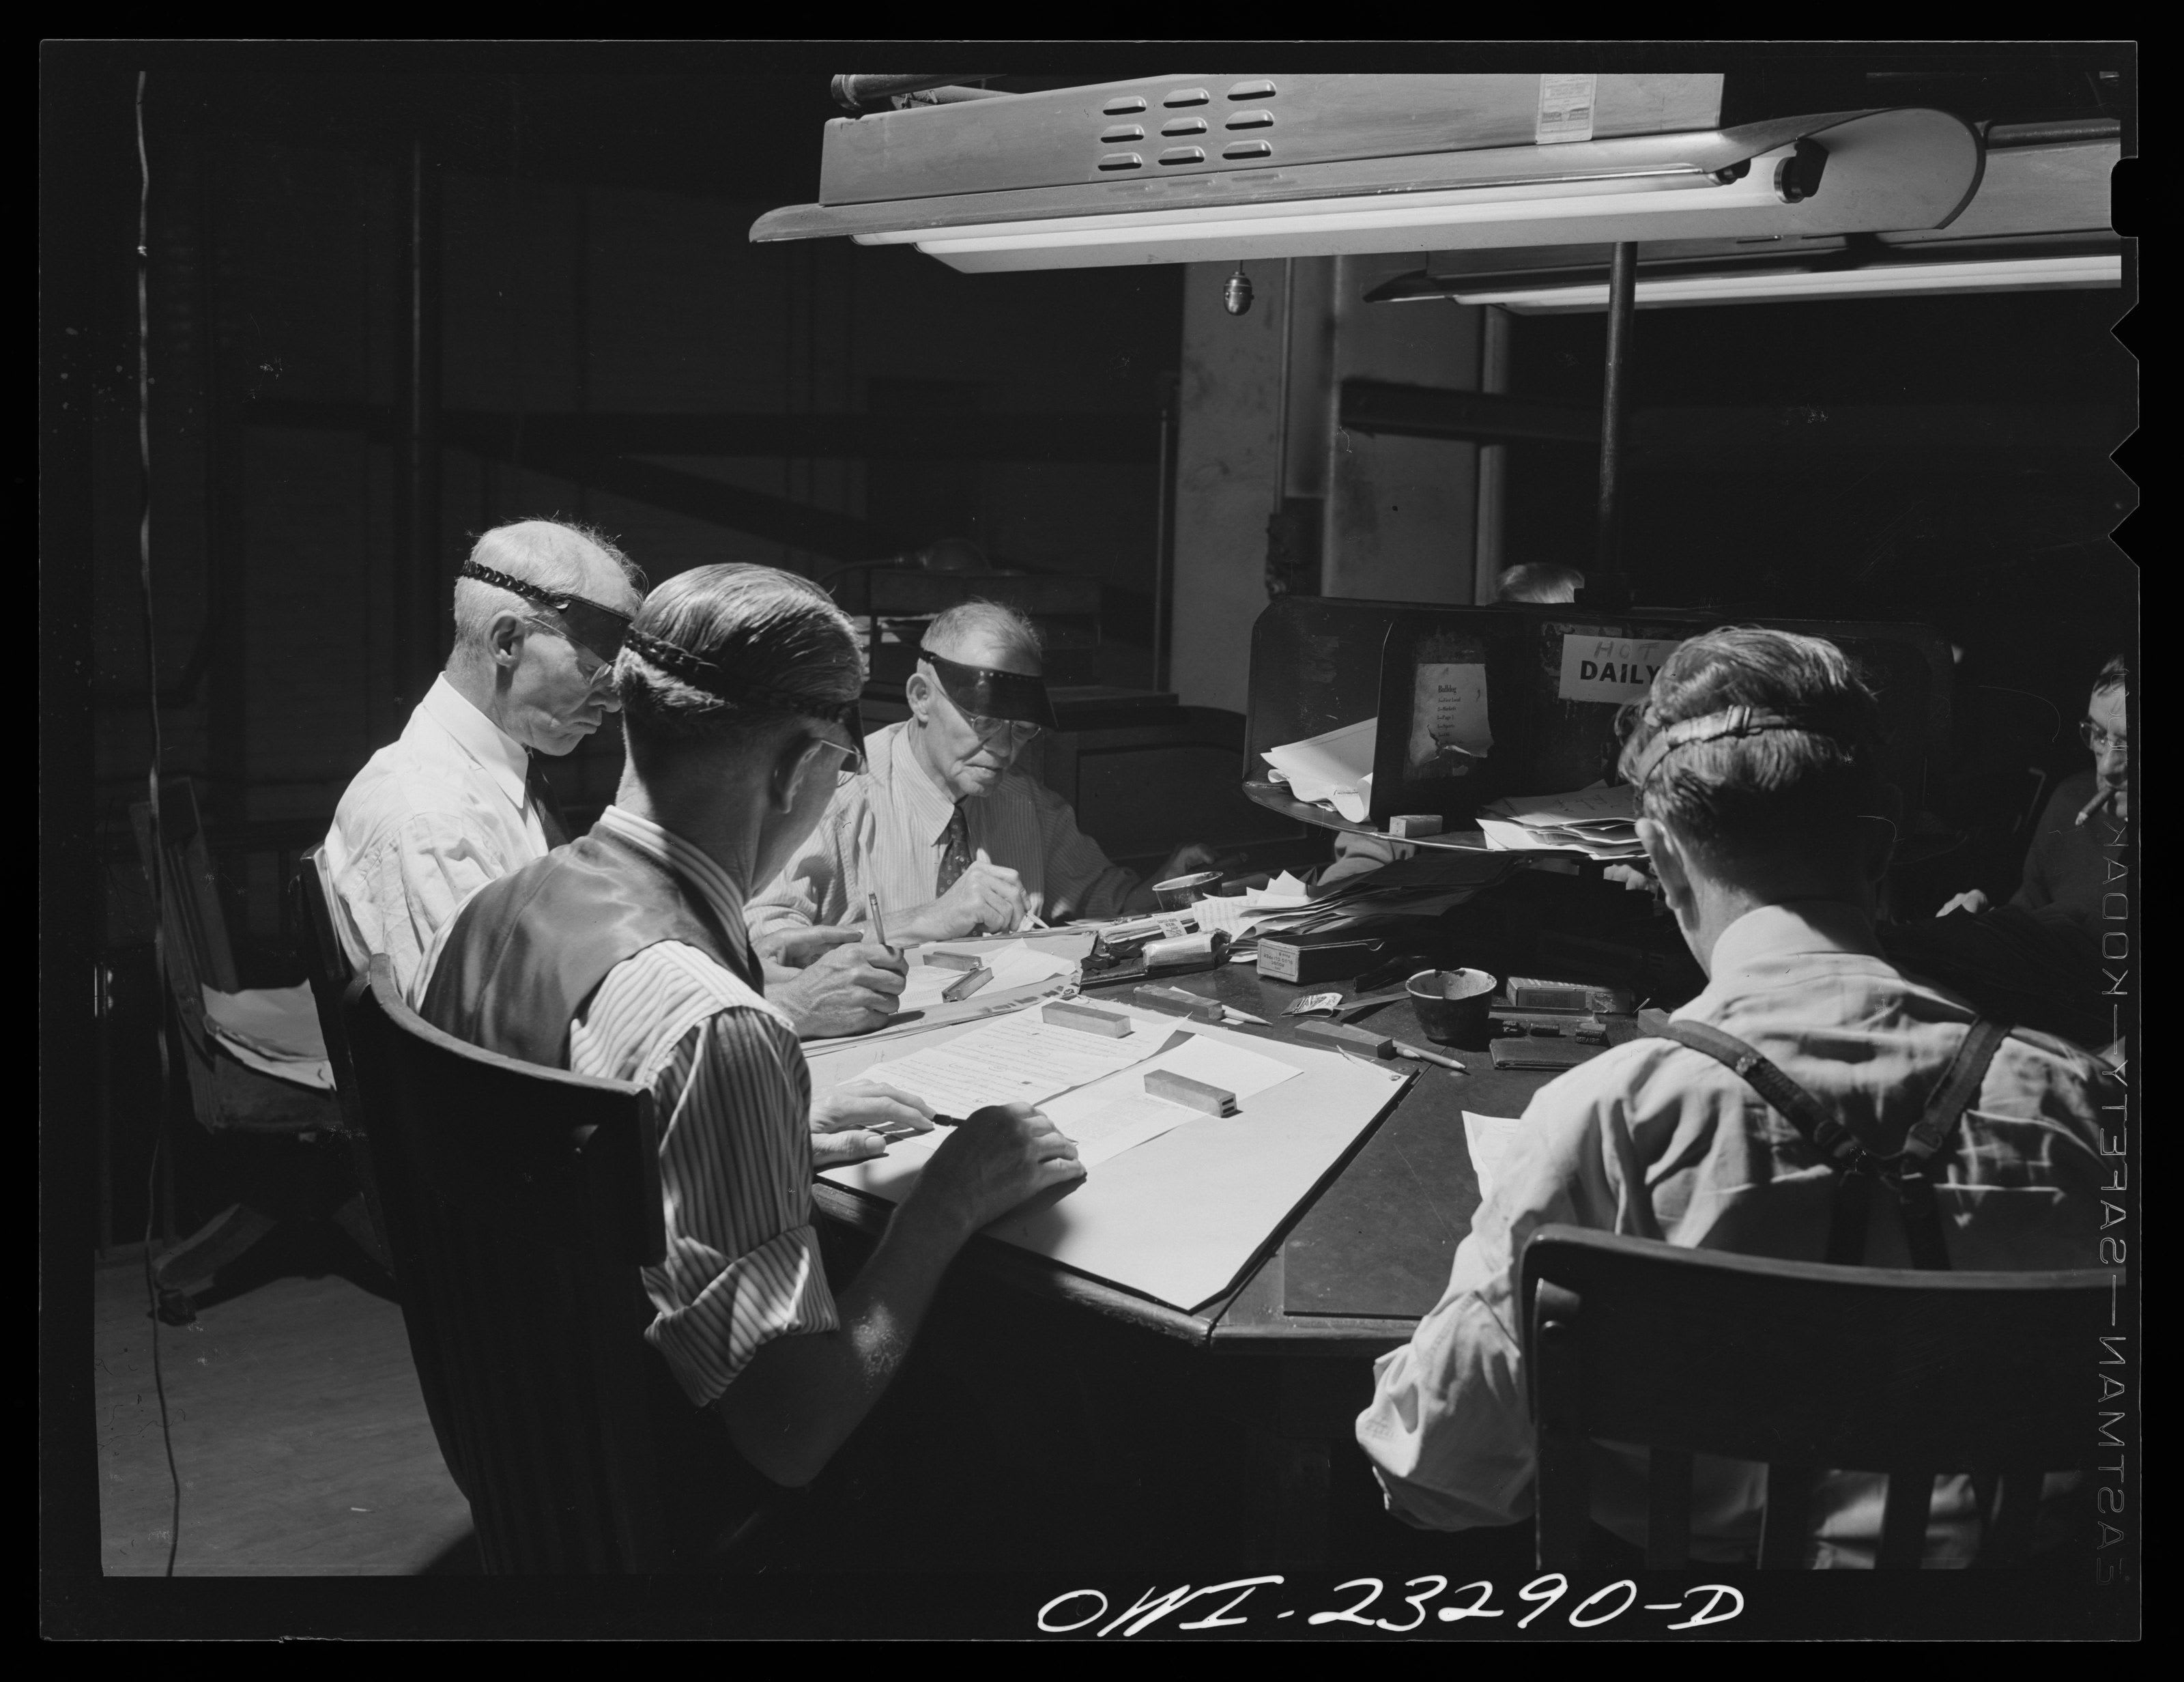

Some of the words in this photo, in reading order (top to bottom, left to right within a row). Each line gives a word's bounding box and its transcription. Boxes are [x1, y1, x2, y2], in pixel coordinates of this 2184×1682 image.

[1594, 640, 1661, 661] HOT
[1580, 660, 1662, 685] DAILY
[1438, 684, 1457, 695] Bulldog
[1263, 953, 1280, 962] CLIPPER
